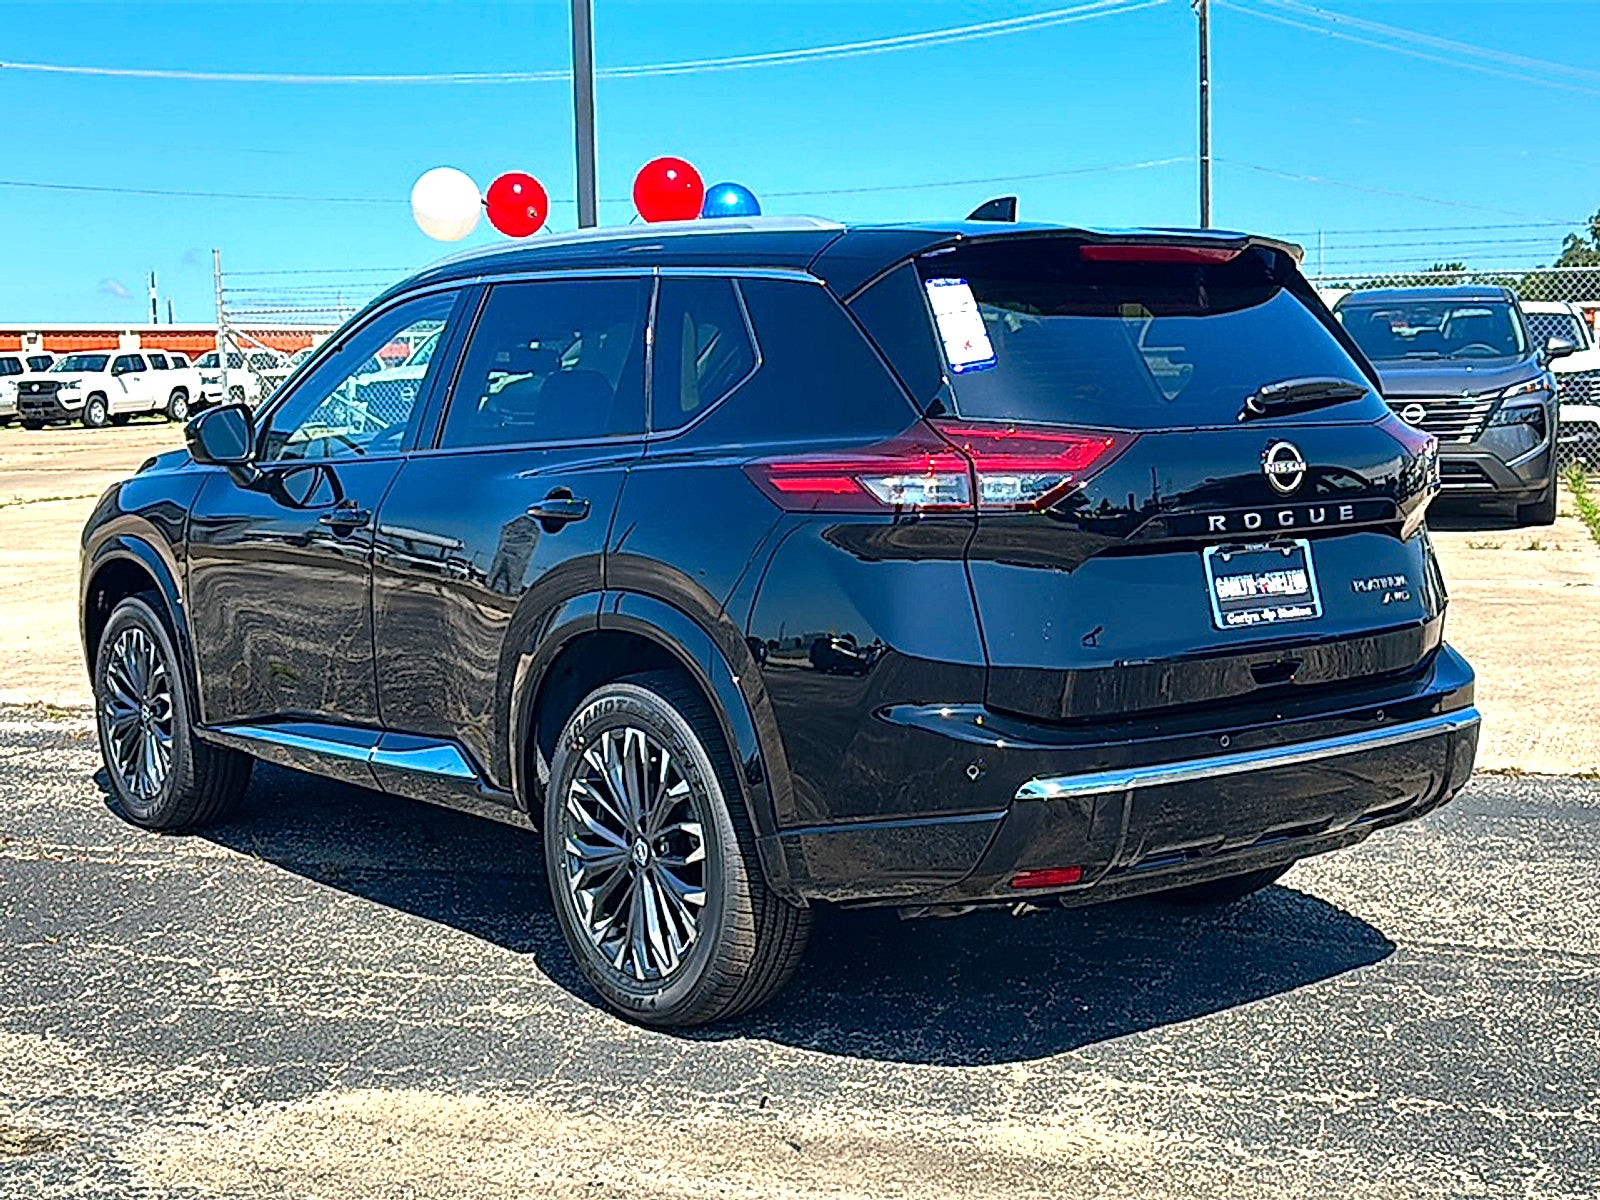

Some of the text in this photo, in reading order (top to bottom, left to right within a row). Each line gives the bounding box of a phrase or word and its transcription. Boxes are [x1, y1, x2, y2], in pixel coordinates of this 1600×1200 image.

[1264, 461, 1307, 475] NISSAN
[1207, 505, 1354, 531] ROGUE
[1351, 575, 1407, 592] PLATINUM
[1382, 589, 1411, 604] AWD
